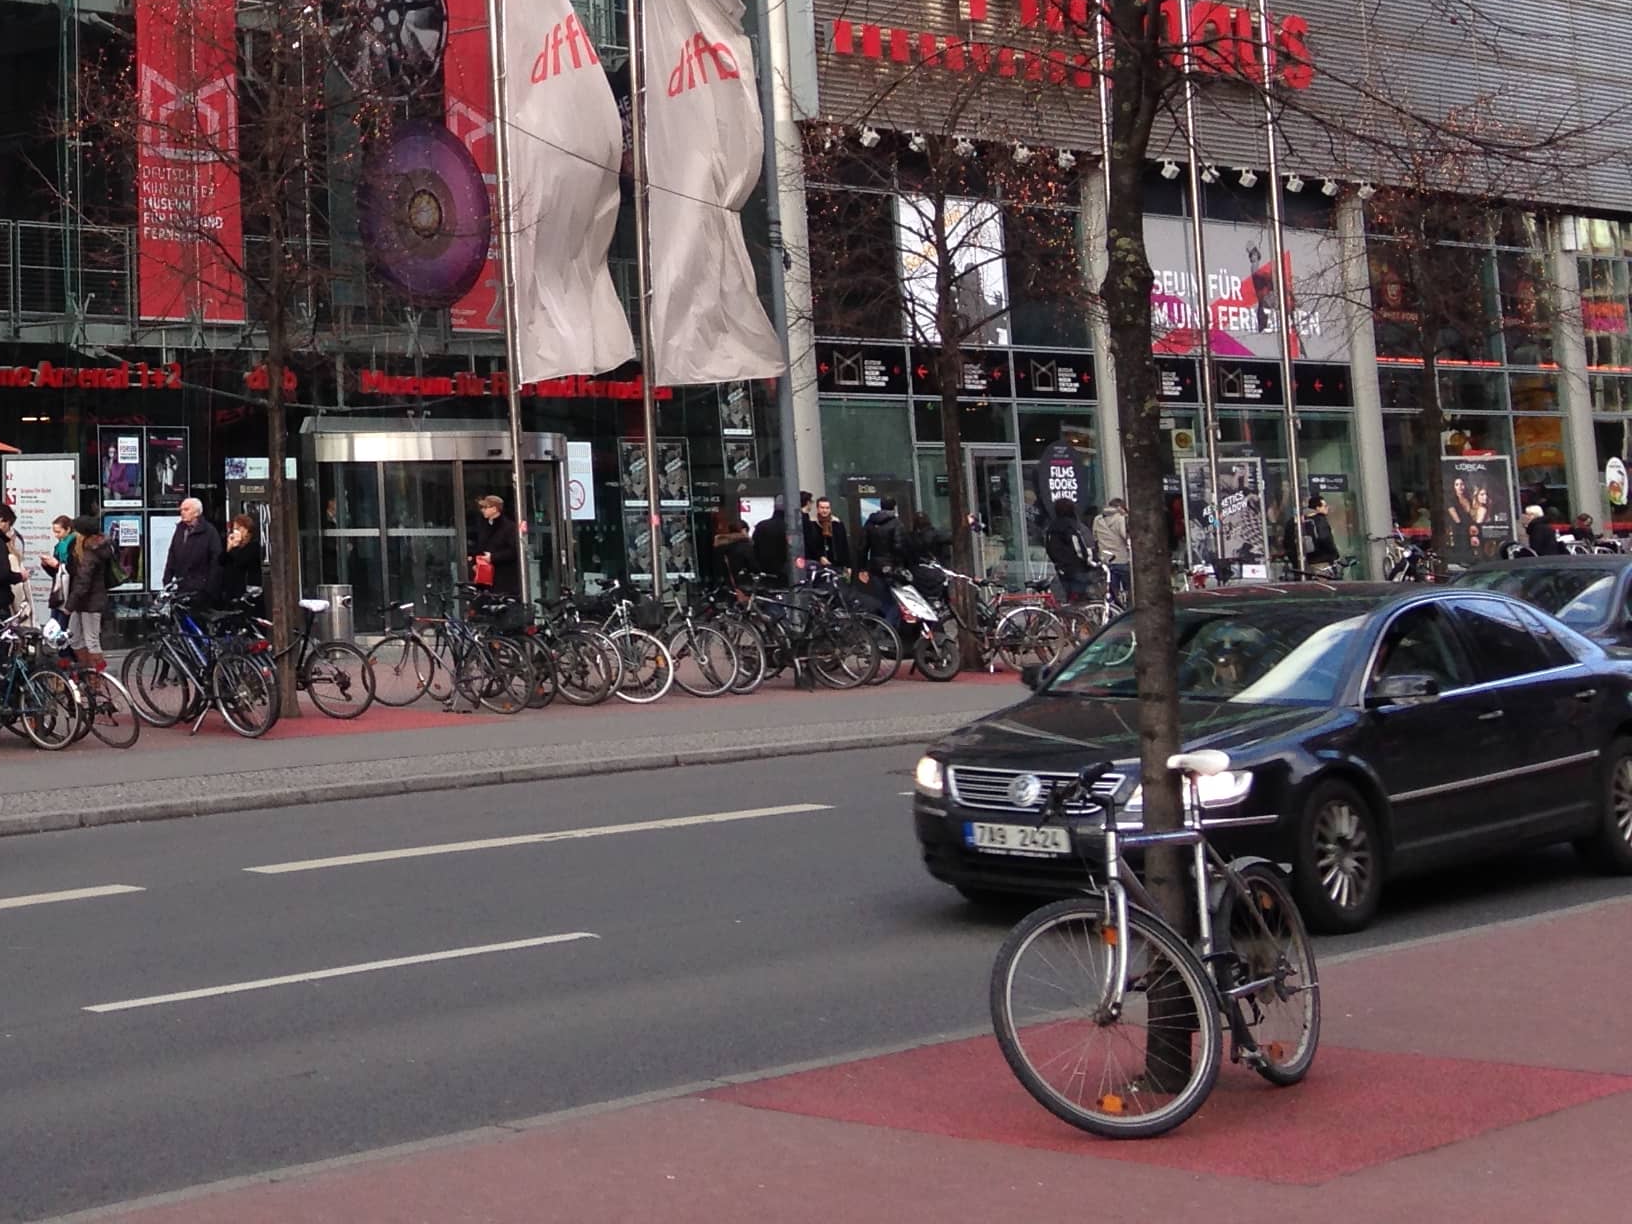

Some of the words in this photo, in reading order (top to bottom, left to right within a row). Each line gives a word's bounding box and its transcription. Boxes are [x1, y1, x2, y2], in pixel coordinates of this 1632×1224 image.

[1208, 268, 1243, 301] FÜR
[37, 360, 129, 389] Arsenal
[1049, 465, 1075, 478] FILMS
[1048, 478, 1079, 491] BOOKS
